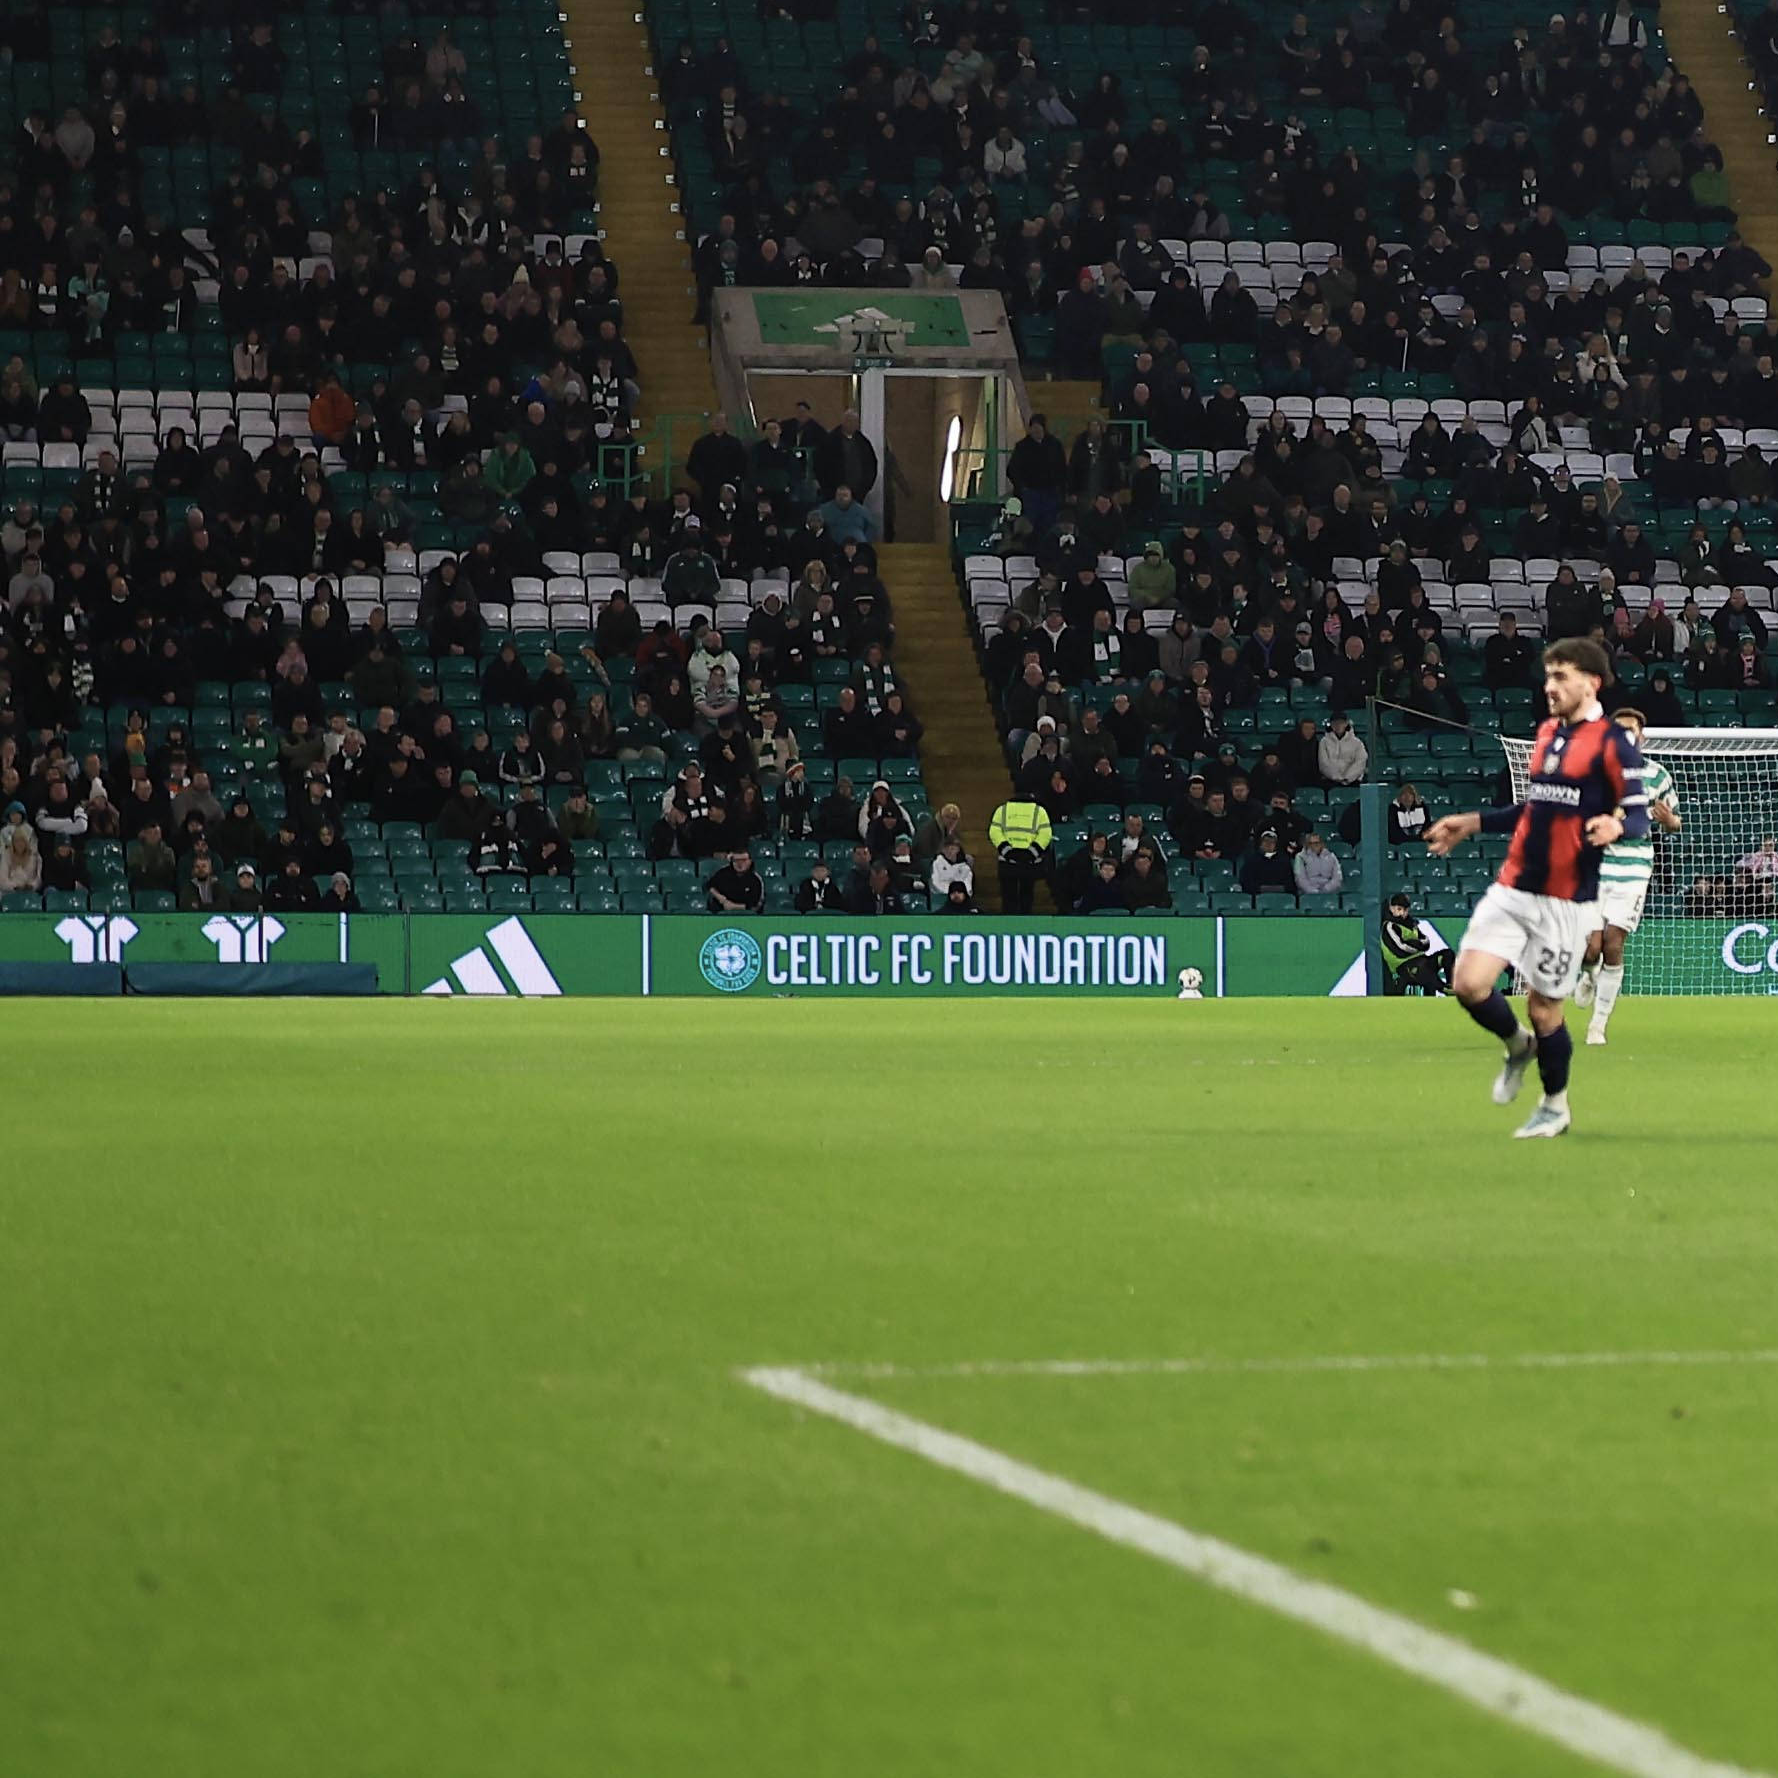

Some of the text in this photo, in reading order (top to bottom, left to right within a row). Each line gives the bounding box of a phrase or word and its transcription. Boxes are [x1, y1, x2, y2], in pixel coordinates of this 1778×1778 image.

[766, 934, 880, 986] CELTIC
[892, 934, 932, 985] FC
[944, 934, 1166, 986] FOUNDATION
[1538, 947, 1572, 976] 28
